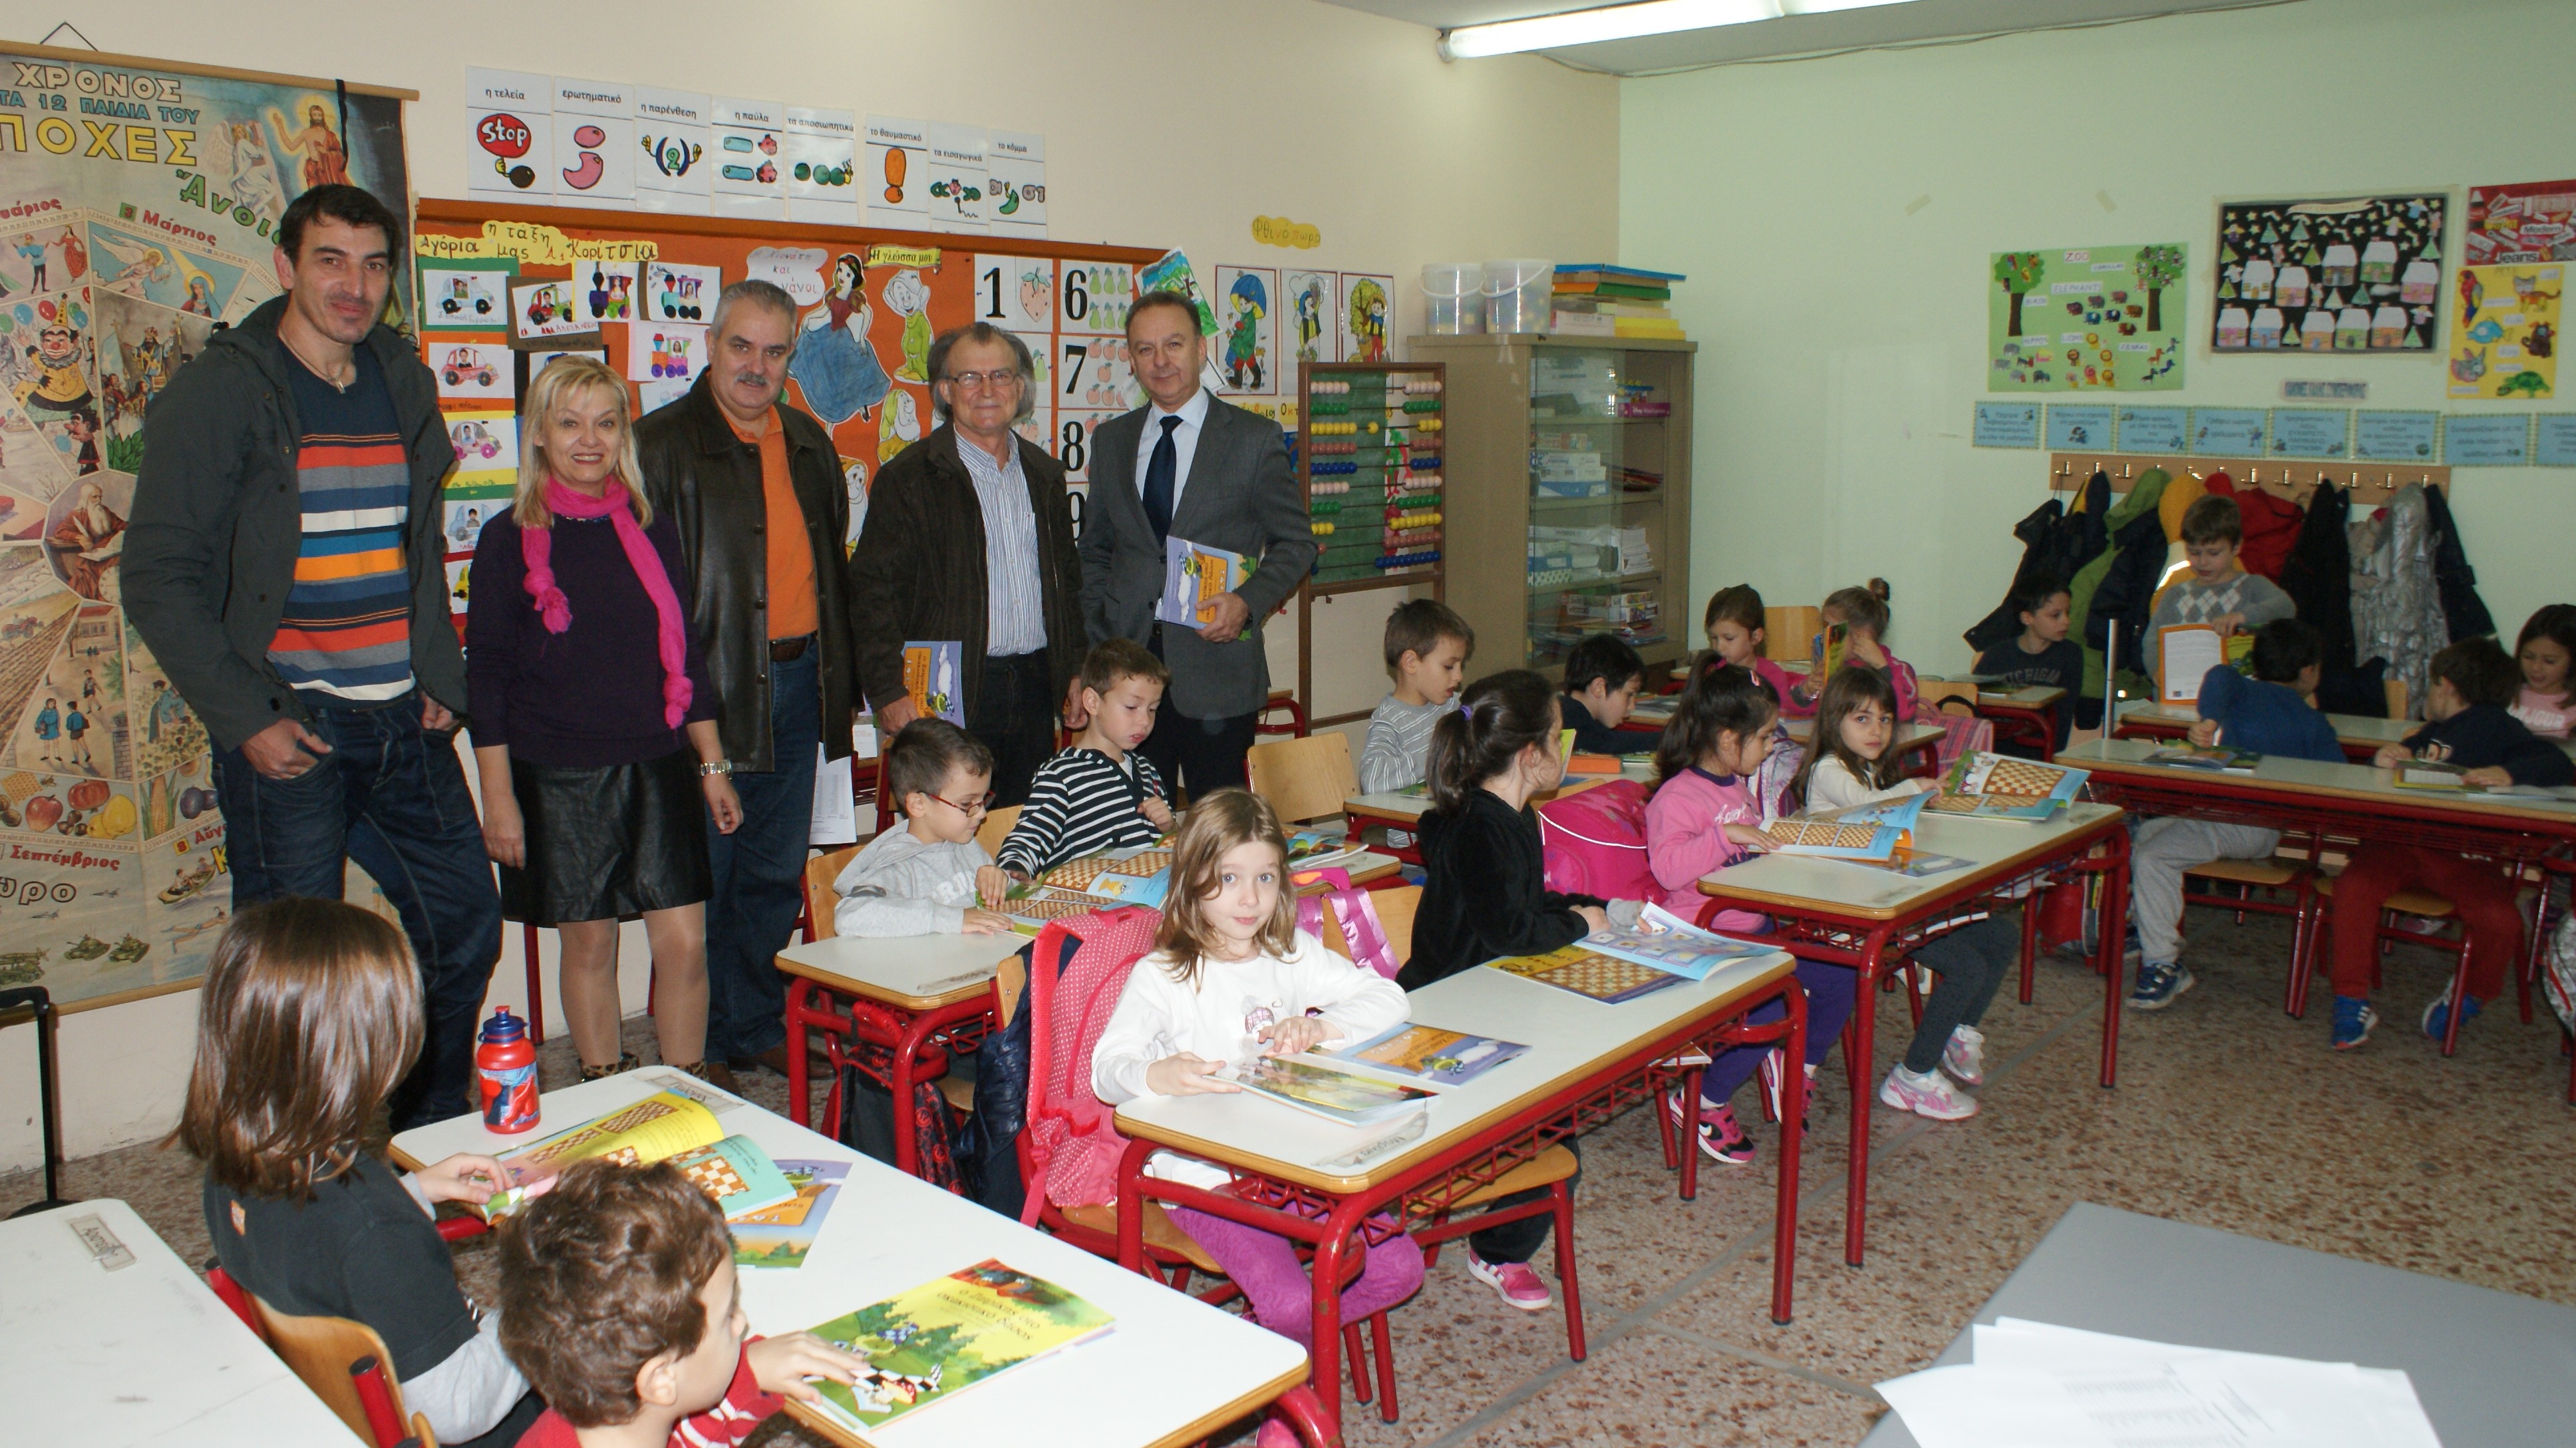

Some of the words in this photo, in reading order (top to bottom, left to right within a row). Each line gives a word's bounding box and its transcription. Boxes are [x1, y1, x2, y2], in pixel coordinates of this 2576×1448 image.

[13, 62, 181, 103] ΧΡΟΝΟΣ
[486, 89, 492, 98] η
[494, 88, 525, 100] τελεία
[562, 89, 621, 104] ερωτηματικό
[0, 90, 26, 108] ΤΑ
[39, 94, 67, 112] 12
[80, 97, 151, 120] ΠΑΙΔΙΑ
[158, 106, 200, 124] ΤΟΥ
[641, 104, 647, 113] η
[649, 102, 697, 119] παρένθεση
[735, 112, 740, 121] η
[742, 110, 769, 123] παύλα
[798, 118, 854, 132] αποσιωπητικά
[0, 113, 197, 166] ΠΟΧΕΣ
[880, 128, 922, 142] θαυμαστικό
[1007, 142, 1027, 153] κόμμα
[943, 150, 983, 162] εισαγωγικά
[123, 205, 133, 218] 3
[142, 210, 217, 246] Μάρτιος
[489, 223, 496, 236] η
[507, 225, 550, 248] τάξη
[1253, 218, 1321, 248] Φθινόπωρο
[420, 236, 480, 259] Αγόρια
[498, 242, 529, 258] μας
[569, 240, 657, 260] Κορίτσια
[882, 249, 916, 265] γλώσσα
[919, 252, 933, 264] μου
[2065, 252, 2089, 262] ZOO
[2496, 252, 2537, 264] Jeans
[773, 265, 790, 273] και
[983, 268, 1006, 319] 1
[1064, 270, 1088, 321] 6
[1065, 345, 1087, 395] 7
[1062, 421, 1084, 472] 8
[177, 840, 187, 852] 8
[10, 844, 120, 870] Σεπτέμβριος
